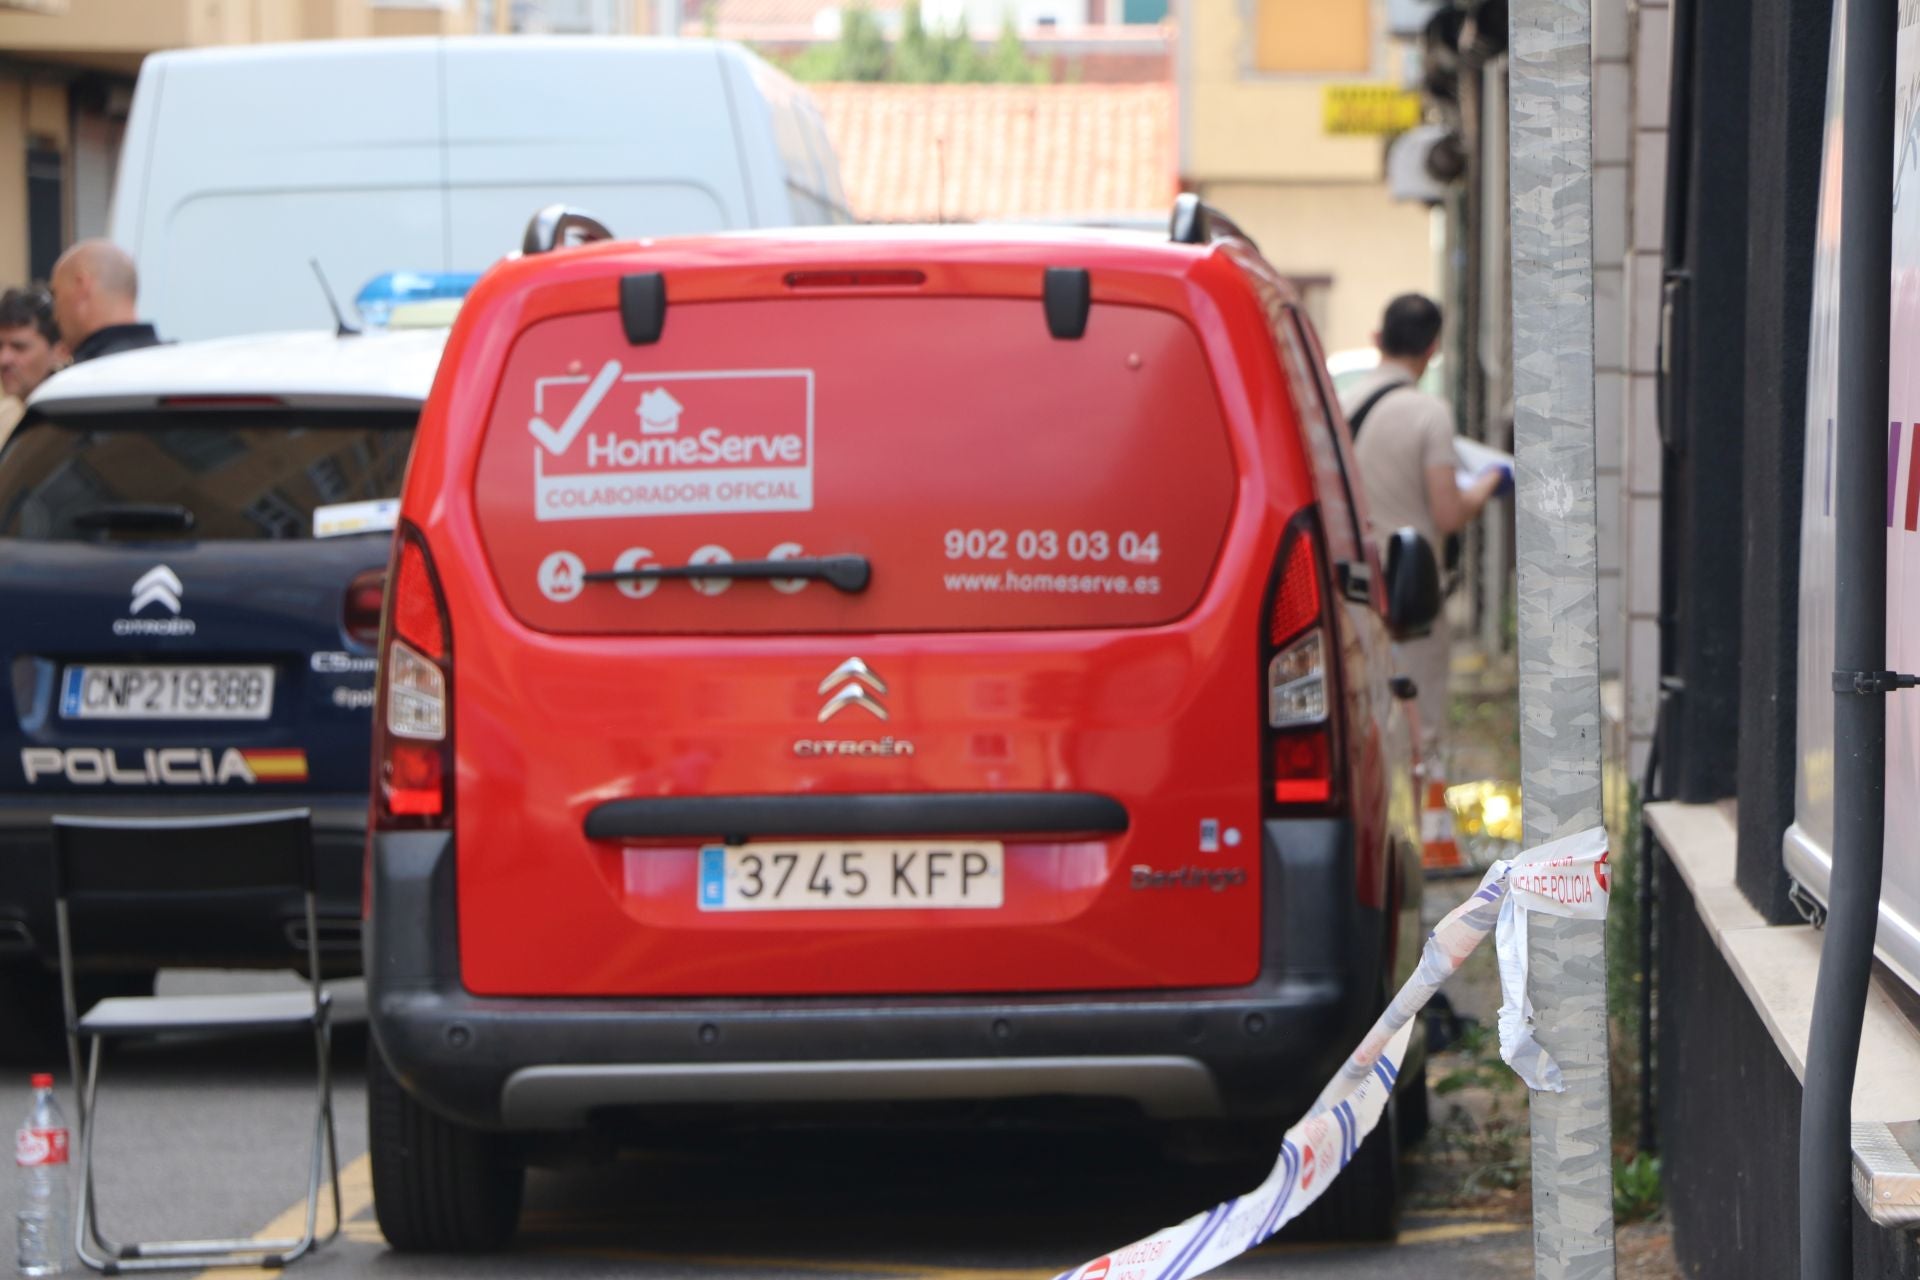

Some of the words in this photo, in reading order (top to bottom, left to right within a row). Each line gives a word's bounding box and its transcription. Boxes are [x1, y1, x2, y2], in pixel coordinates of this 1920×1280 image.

[586, 427, 802, 468] HomeServe
[545, 484, 712, 510] COLABORADOR
[716, 481, 800, 503] OFICIAL
[944, 529, 1008, 559] 902
[1016, 529, 1059, 560] 03
[1067, 530, 1109, 561] 03
[1118, 530, 1161, 562] 04
[944, 569, 1161, 594] www.homeserve.es
[21, 747, 258, 784] POLICIA
[738, 852, 868, 899] 3745
[891, 852, 989, 897] KFP
[1551, 875, 1592, 904] POLICIA
